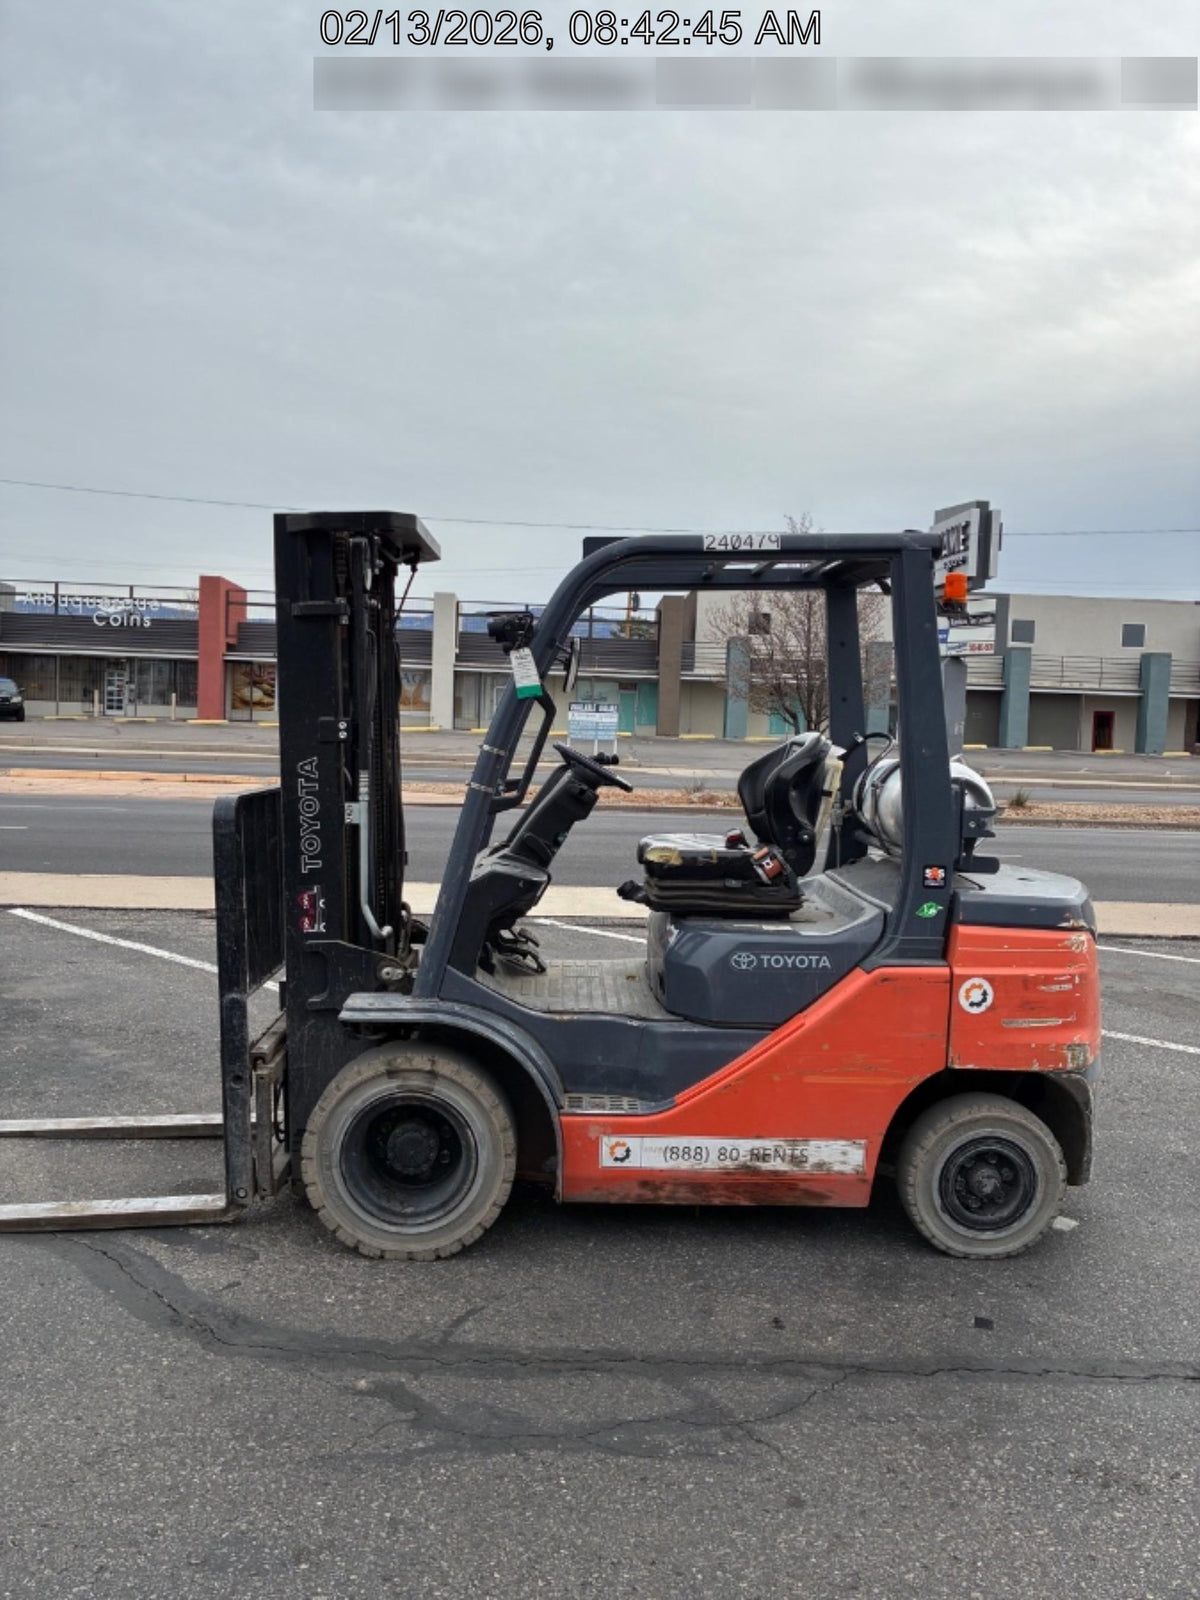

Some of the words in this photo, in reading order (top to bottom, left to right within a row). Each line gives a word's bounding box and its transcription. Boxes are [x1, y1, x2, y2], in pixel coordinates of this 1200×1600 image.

[705, 534, 780, 551] 240479
[92, 611, 152, 628] Coins
[297, 755, 323, 874] TOYOTA
[760, 954, 832, 970] TOYOTA
[663, 1144, 711, 1163] (888)
